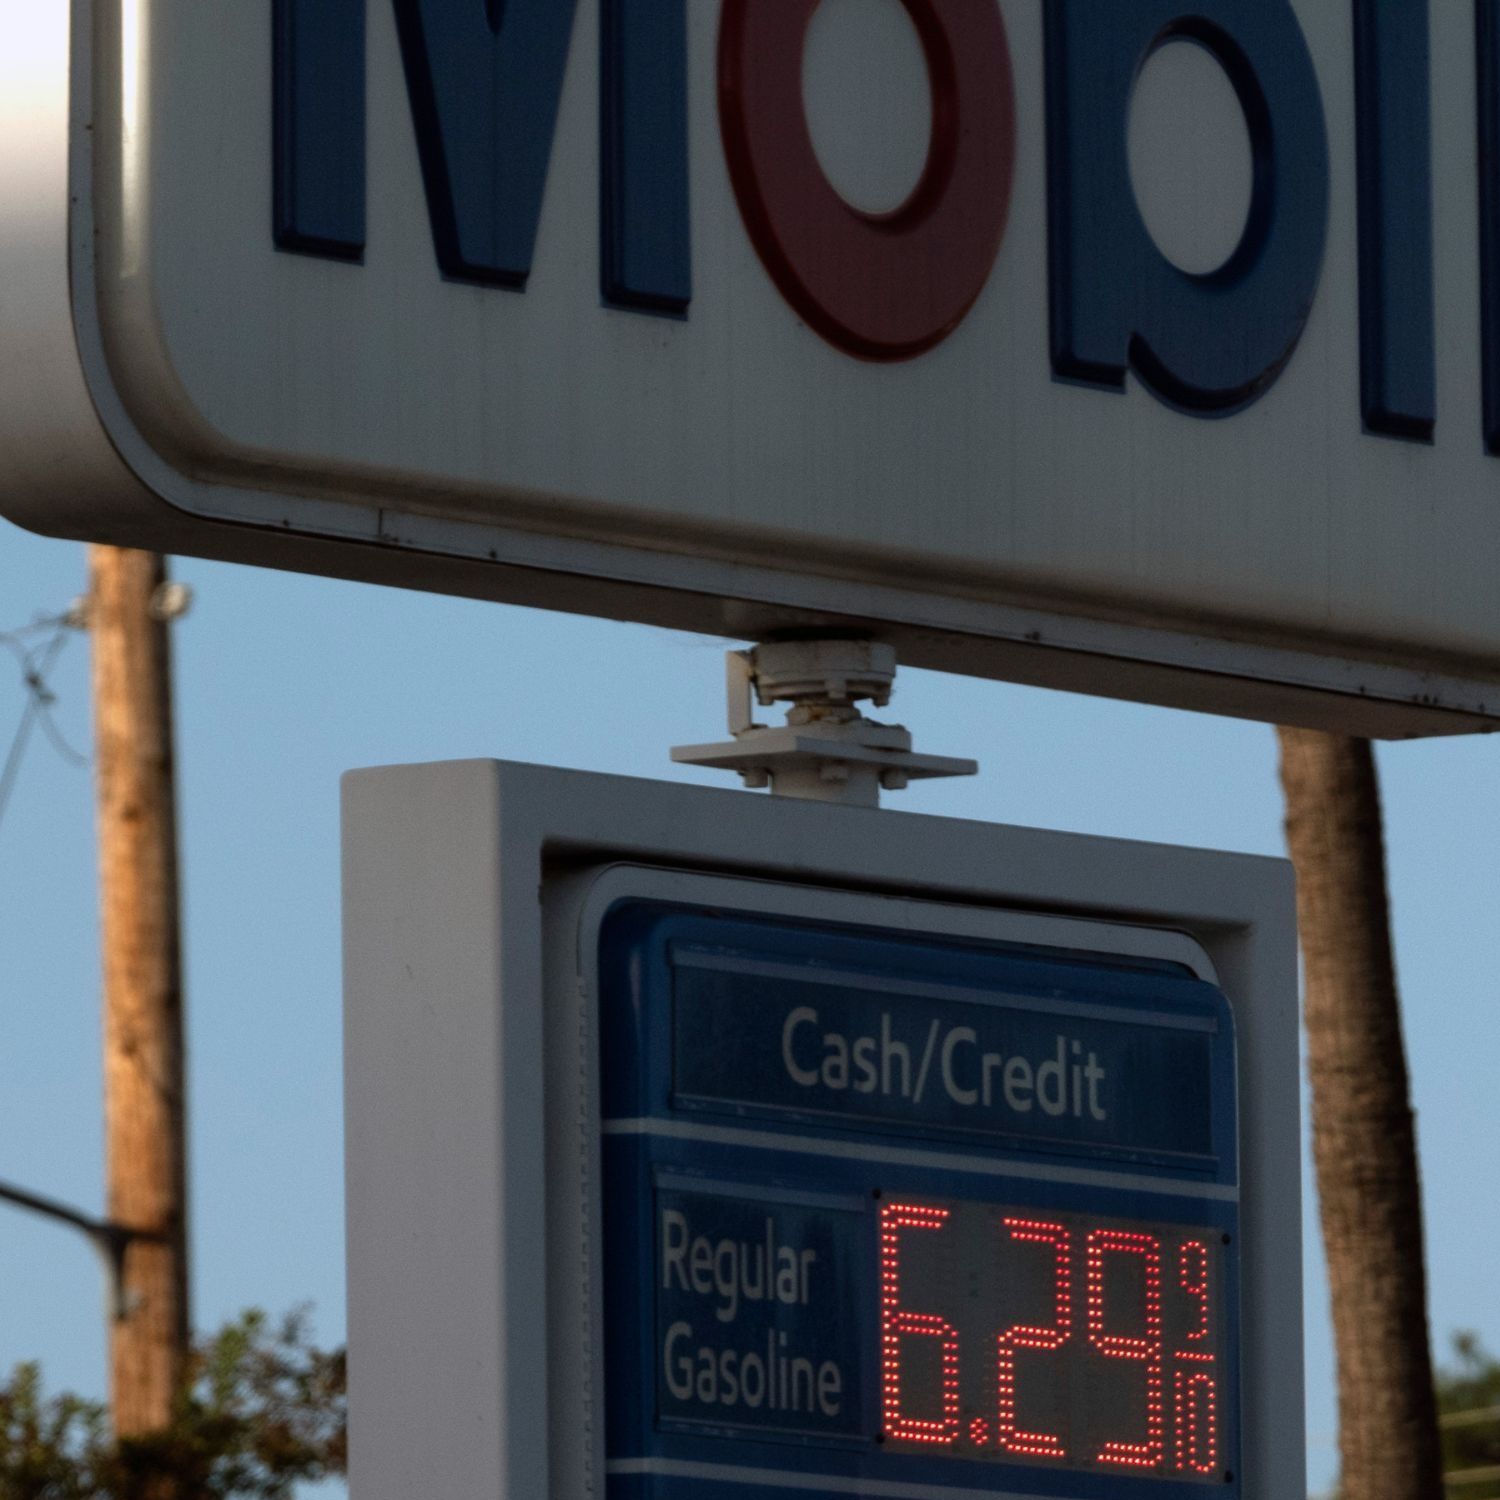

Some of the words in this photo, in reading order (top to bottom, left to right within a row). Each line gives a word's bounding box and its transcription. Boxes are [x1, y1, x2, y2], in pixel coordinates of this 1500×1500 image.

[781, 1006, 1107, 1121] Cash/Credit
[661, 1208, 816, 1323] Regular
[663, 1321, 842, 1417] Gasoline
[882, 1204, 1164, 1466] 6.29
